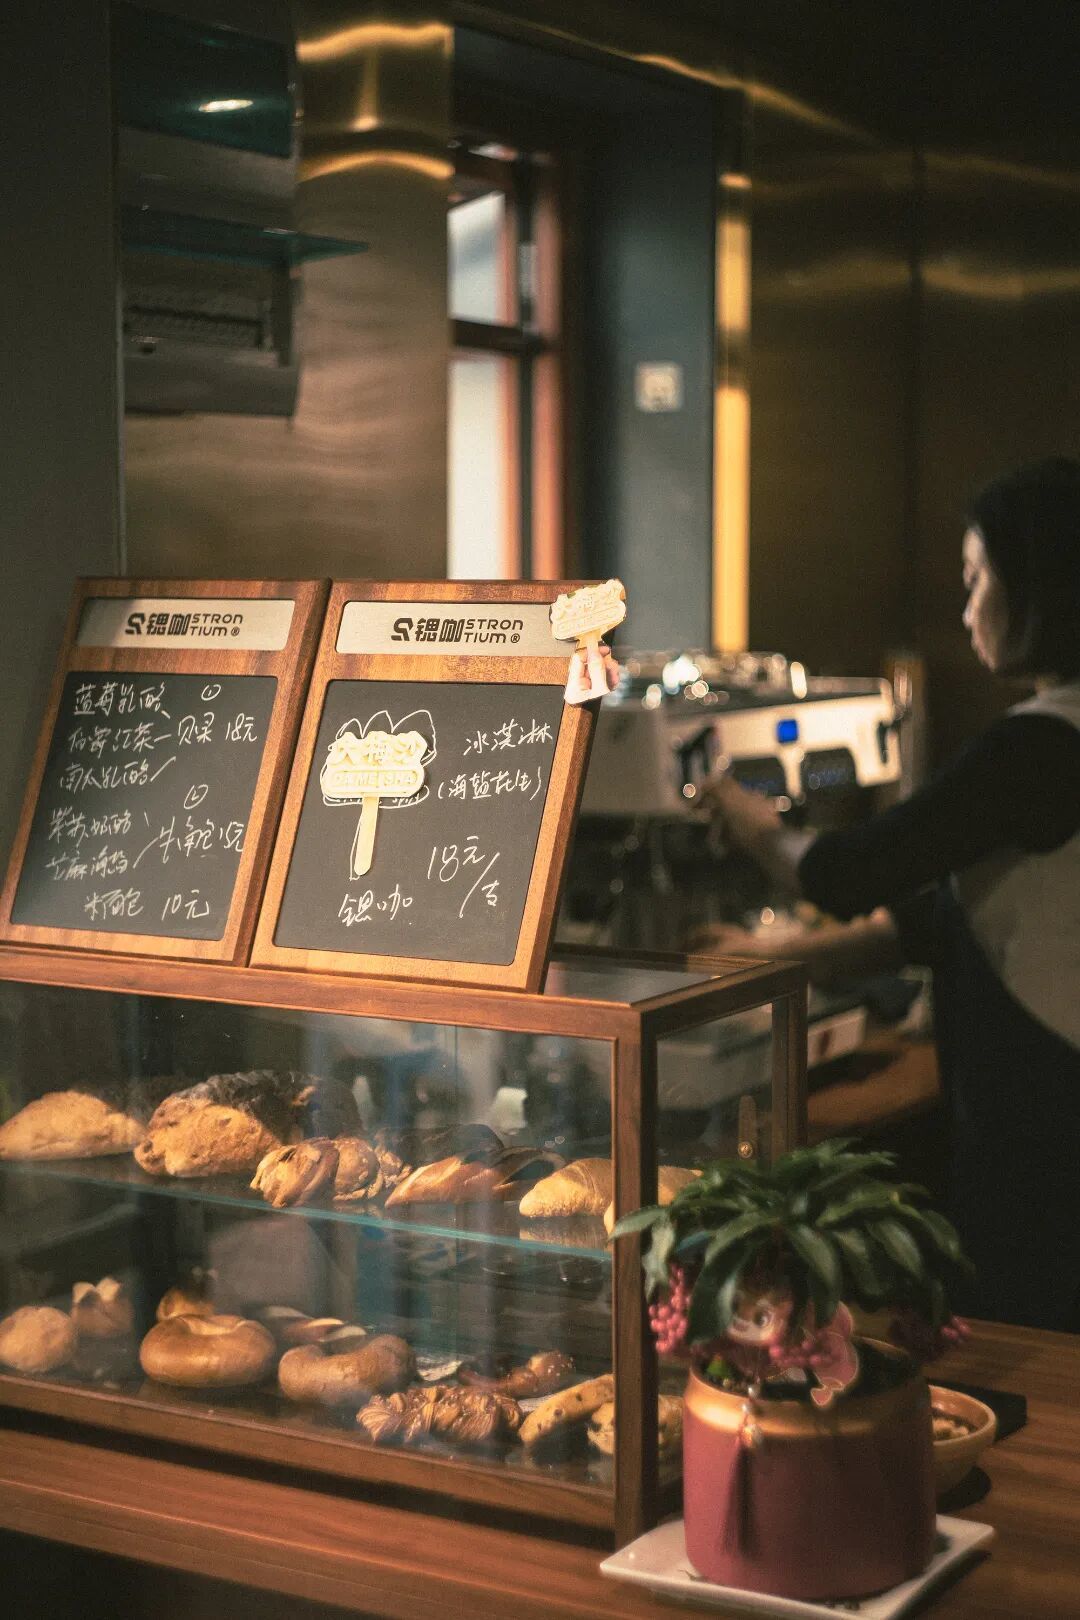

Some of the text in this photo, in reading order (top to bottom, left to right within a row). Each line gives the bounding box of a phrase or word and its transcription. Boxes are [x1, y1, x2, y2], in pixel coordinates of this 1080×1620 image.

[191, 613, 244, 625] STRON
[465, 618, 524, 631] STRON
[177, 711, 259, 747] 贝果 18元
[161, 888, 210, 923] 10元
